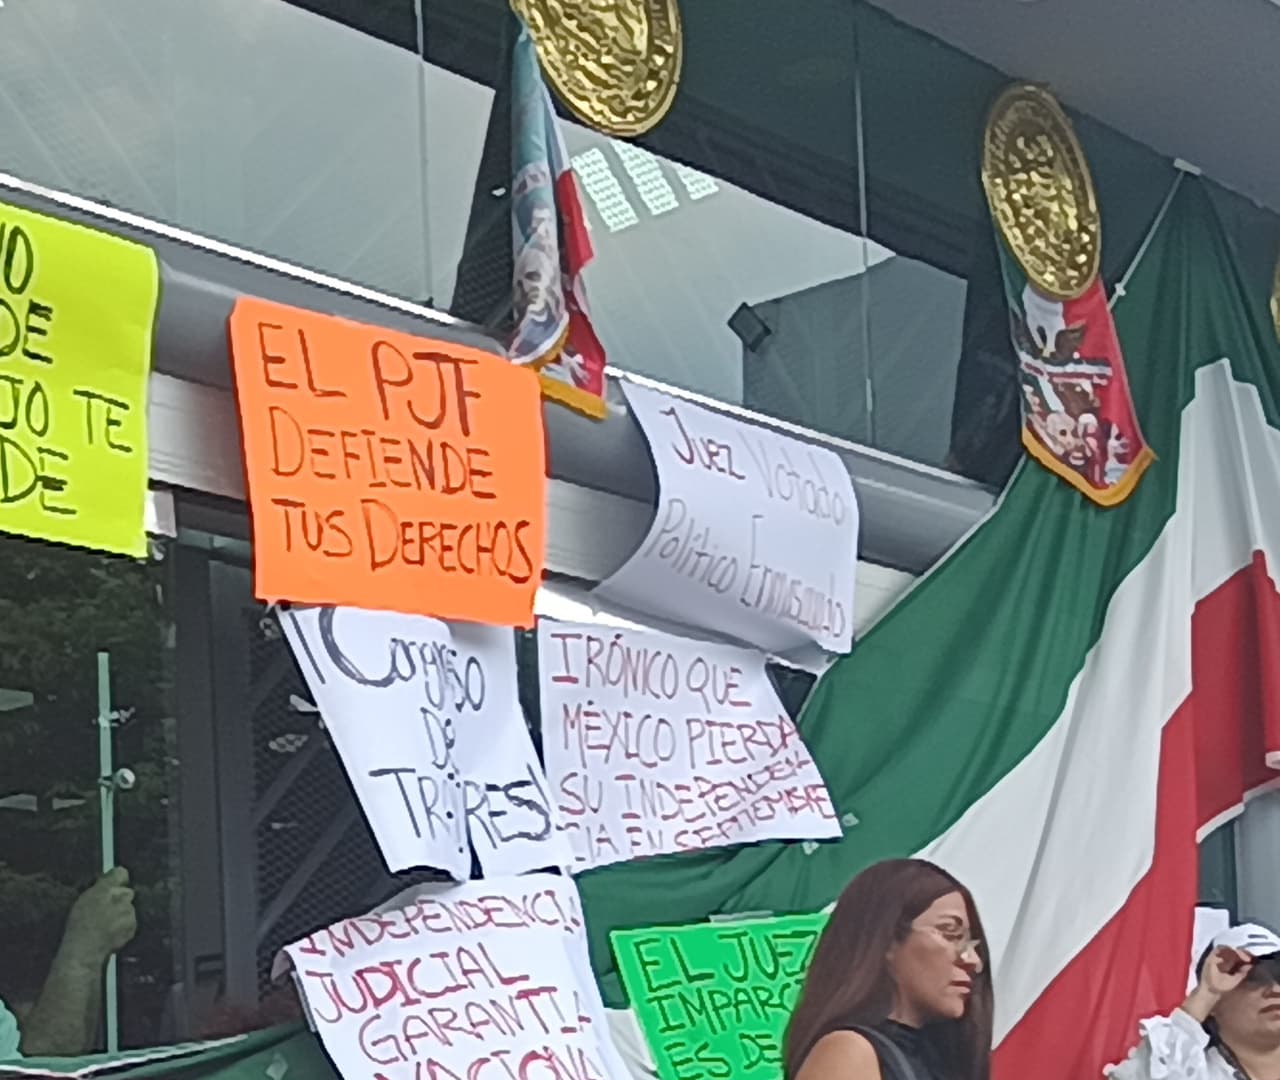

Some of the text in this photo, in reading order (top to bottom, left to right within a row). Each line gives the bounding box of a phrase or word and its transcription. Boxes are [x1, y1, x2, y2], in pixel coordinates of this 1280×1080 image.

[258, 321, 482, 437] EL PJF
[73, 388, 133, 453] TE
[269, 405, 498, 499] DEFIENDE
[271, 498, 533, 584] TUS DERECHOS
[550, 632, 753, 715] IRÓNICO QUE
[685, 713, 801, 770] PIERDA
[558, 771, 604, 815] SU
[625, 826, 663, 855] EN
[305, 942, 530, 1024] JUDICIAL
[632, 935, 716, 994] EL
